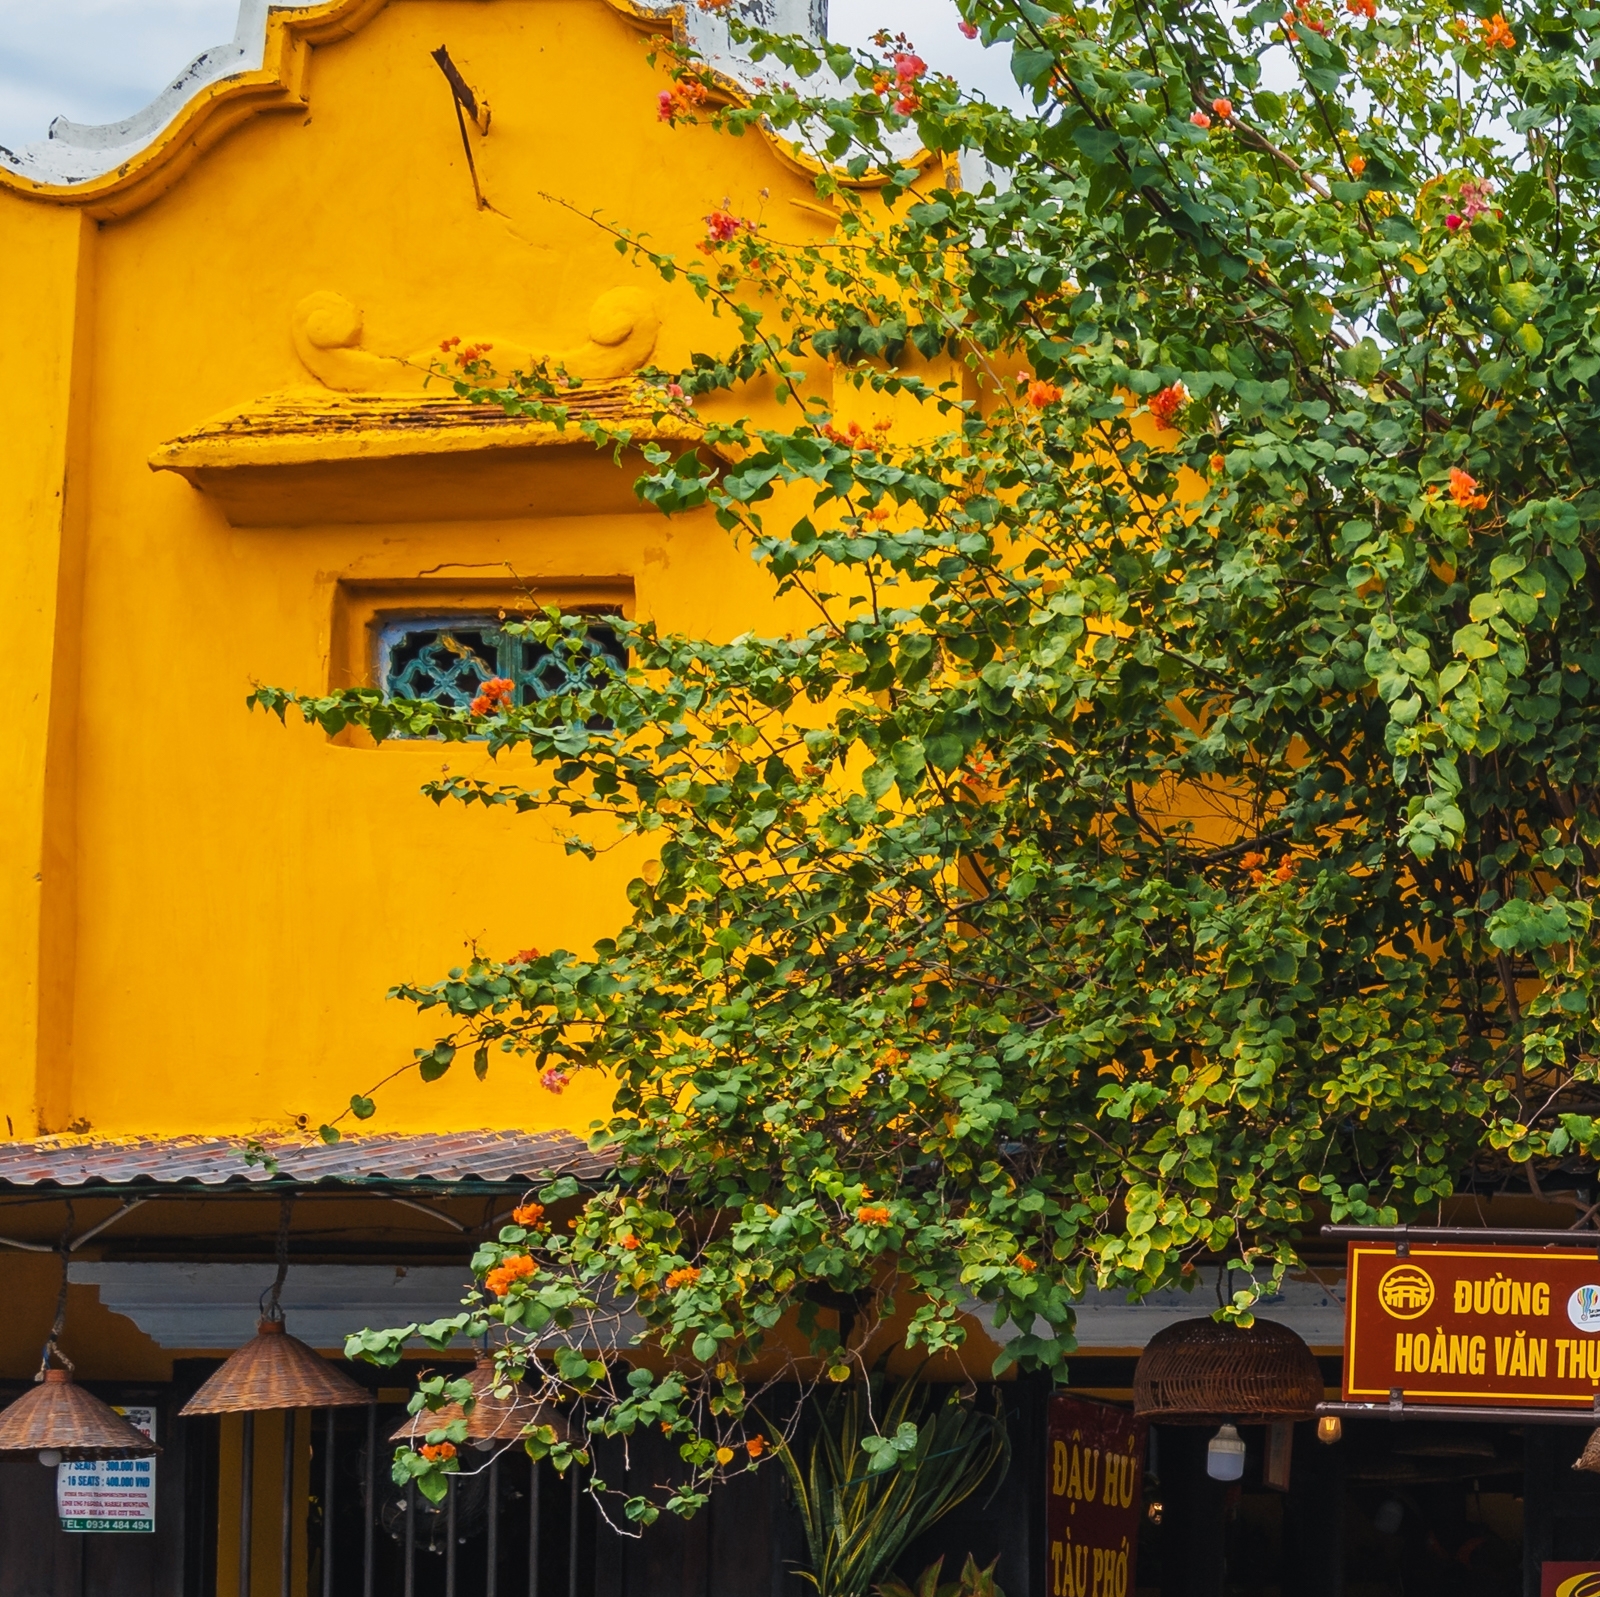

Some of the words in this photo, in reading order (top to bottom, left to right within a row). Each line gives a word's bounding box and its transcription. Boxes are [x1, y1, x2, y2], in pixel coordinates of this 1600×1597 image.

[1453, 1272, 1550, 1316] ĐƯỜNG
[1395, 1325, 1486, 1376] HOÀNG
[1494, 1330, 1548, 1378] VĂN
[74, 1461, 97, 1471] SEATS
[1053, 1428, 1100, 1515] ĐẬU
[1103, 1434, 1137, 1509] HỦ
[68, 1476, 76, 1486] 16
[78, 1476, 100, 1487] SEATS
[106, 1476, 134, 1488] 400.000
[61, 1519, 84, 1529] TEL:
[86, 1520, 110, 1529] 0934
[112, 1520, 130, 1529] 484
[132, 1520, 150, 1529] 494
